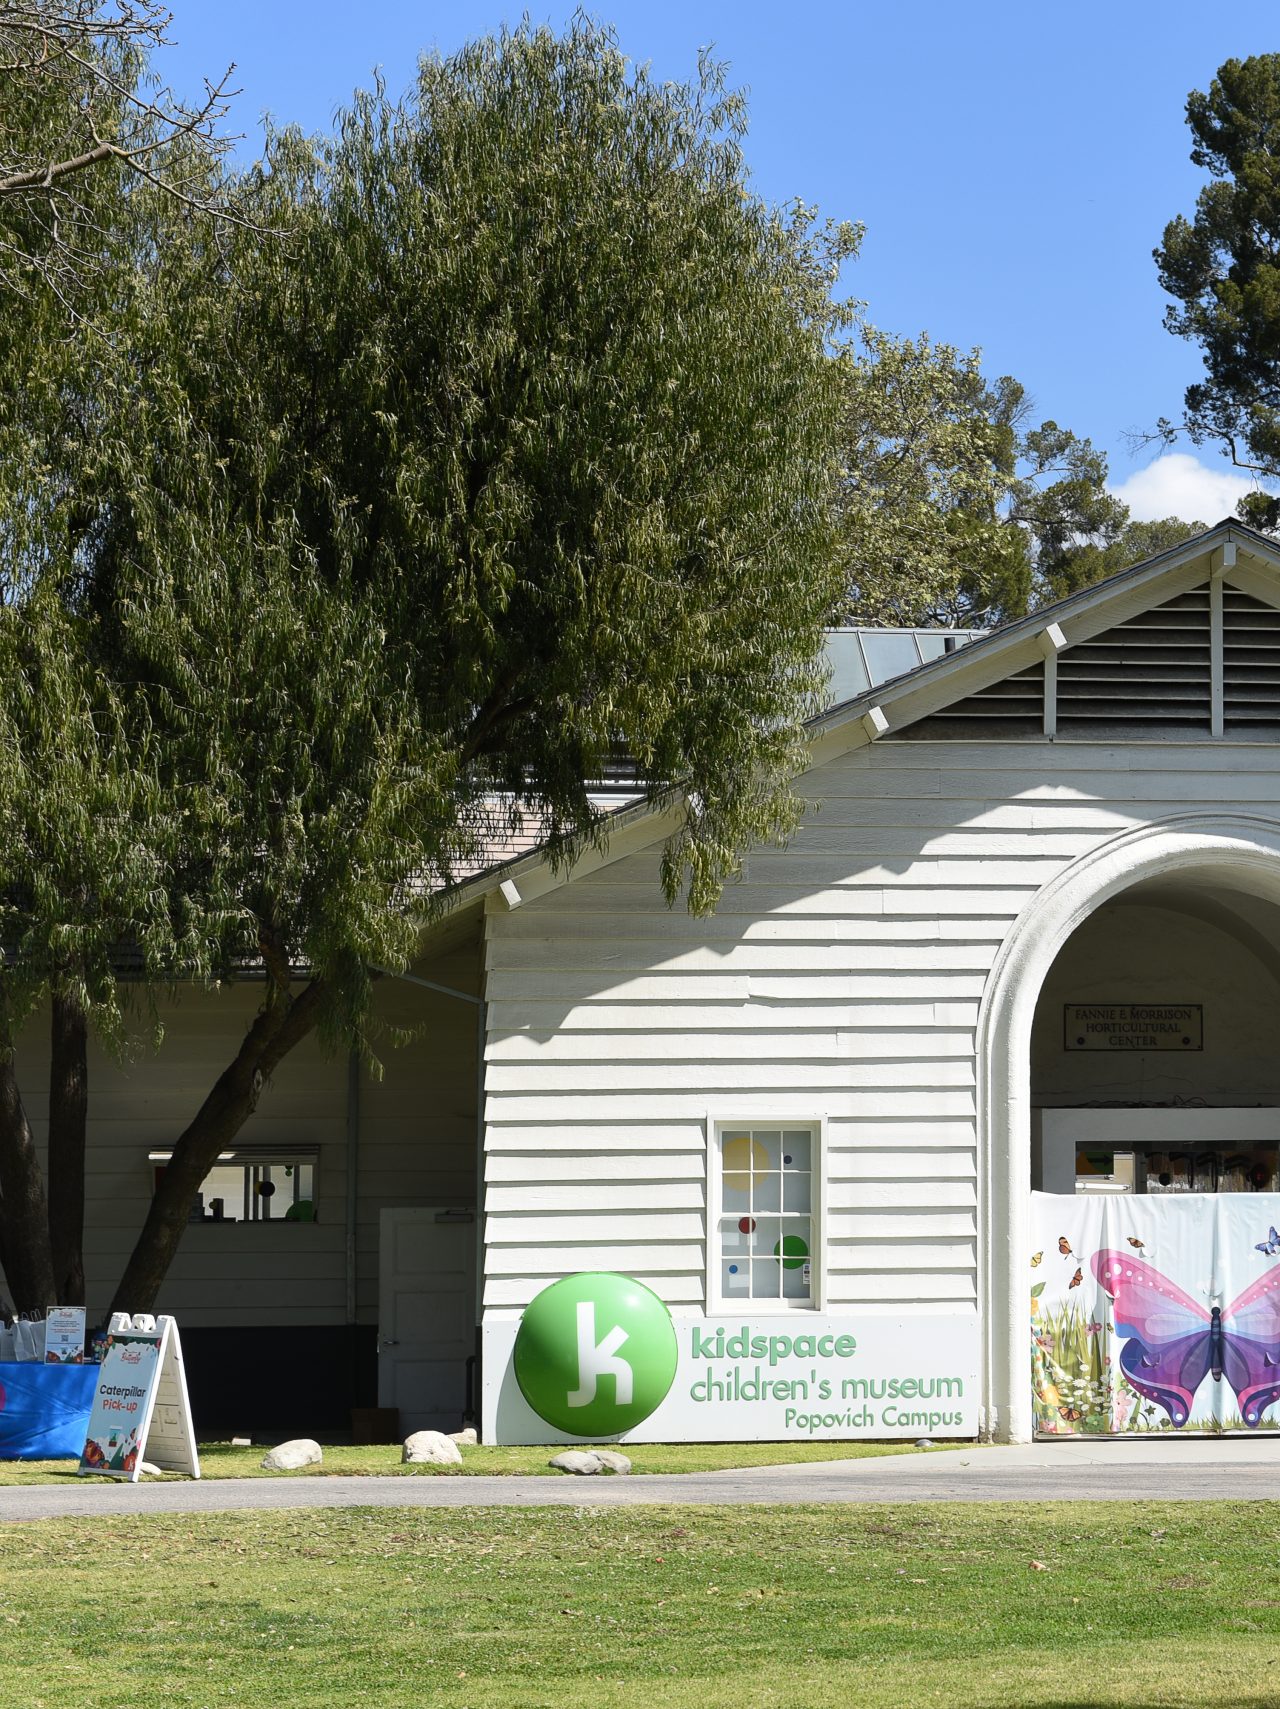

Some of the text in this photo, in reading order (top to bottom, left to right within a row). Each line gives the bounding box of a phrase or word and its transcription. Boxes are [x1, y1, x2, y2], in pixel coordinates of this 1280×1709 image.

[1075, 1009, 1116, 1020] FANNIE
[1130, 1008, 1192, 1020] MORRISON
[1086, 1023, 1181, 1033] HORTICULTURAL
[1109, 1036, 1157, 1046] CENTER
[691, 1326, 857, 1366] kidspace
[690, 1366, 963, 1401] children's museum
[100, 1384, 146, 1400] Caterpillar
[103, 1399, 138, 1413] Pick-up
[785, 1404, 963, 1434] Popovich Campus
